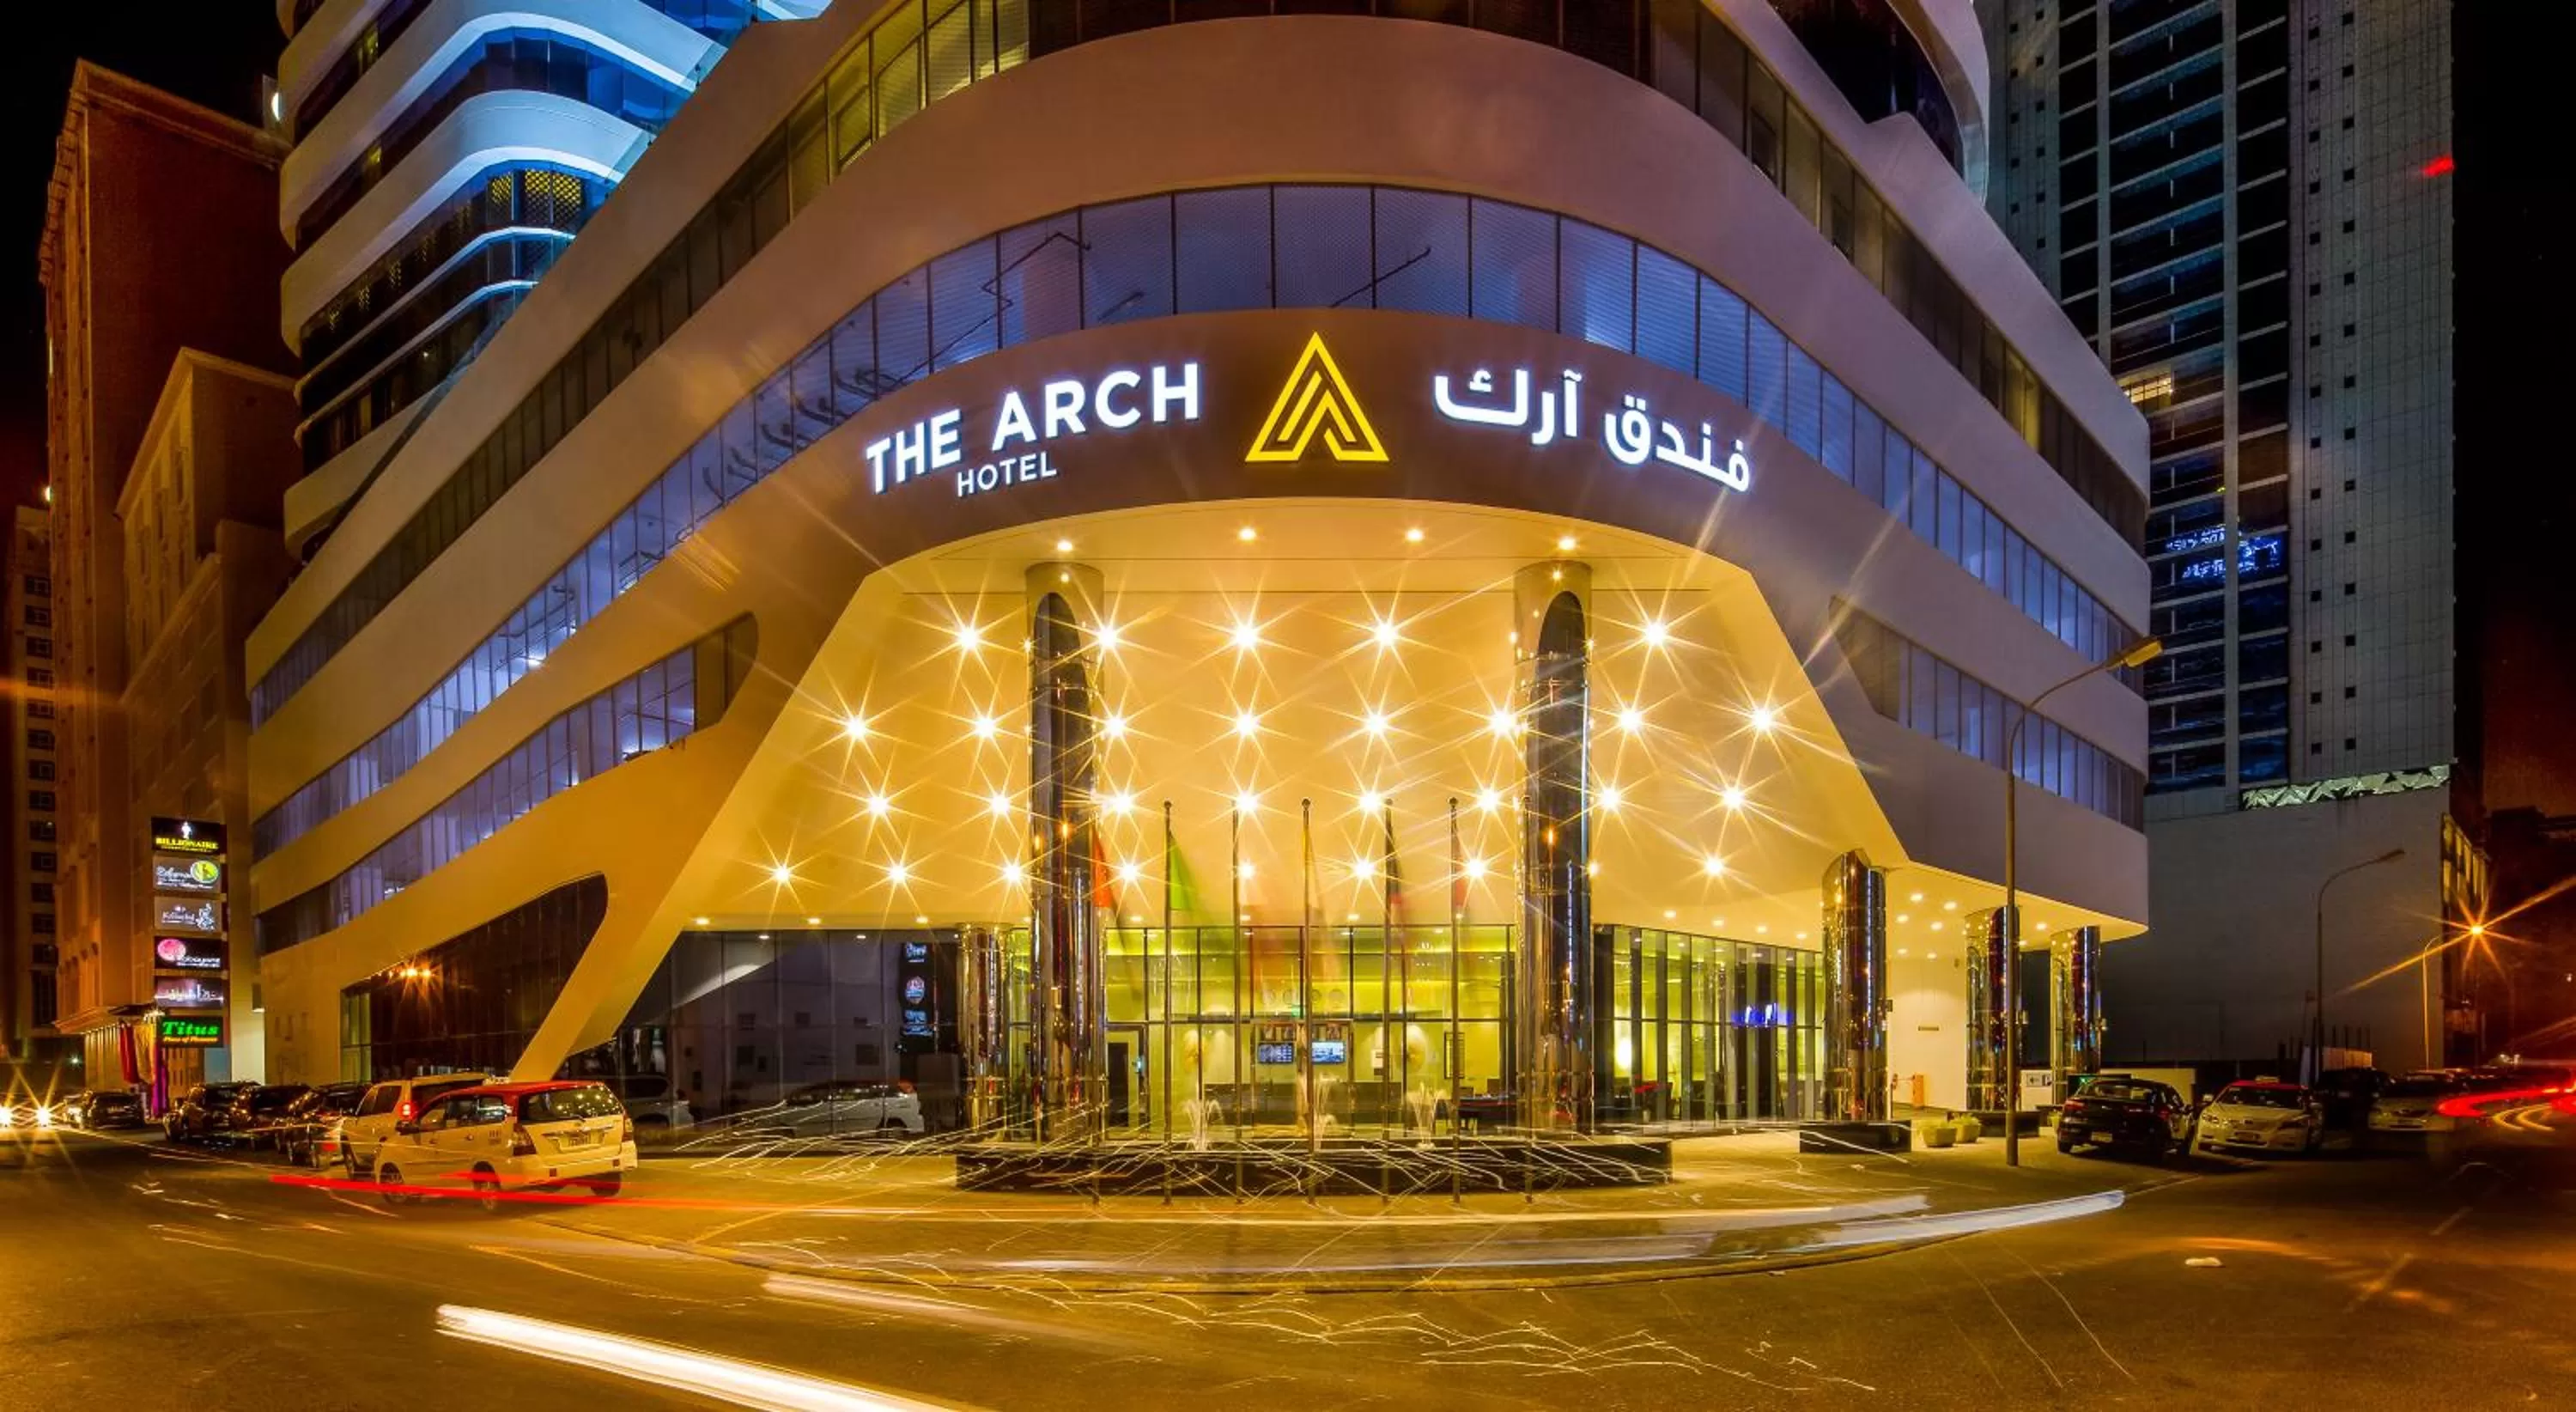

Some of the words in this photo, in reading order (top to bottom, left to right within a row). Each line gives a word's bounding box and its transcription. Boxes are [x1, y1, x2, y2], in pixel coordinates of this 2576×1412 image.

[866, 409, 963, 493] THE
[992, 362, 1199, 451] ARCH
[1435, 369, 1582, 446] آرك
[1605, 394, 1750, 492] فندق
[957, 451, 1057, 497] HOTEL
[155, 837, 219, 849] BILLIONAIRE
[163, 1021, 219, 1035] Titus
